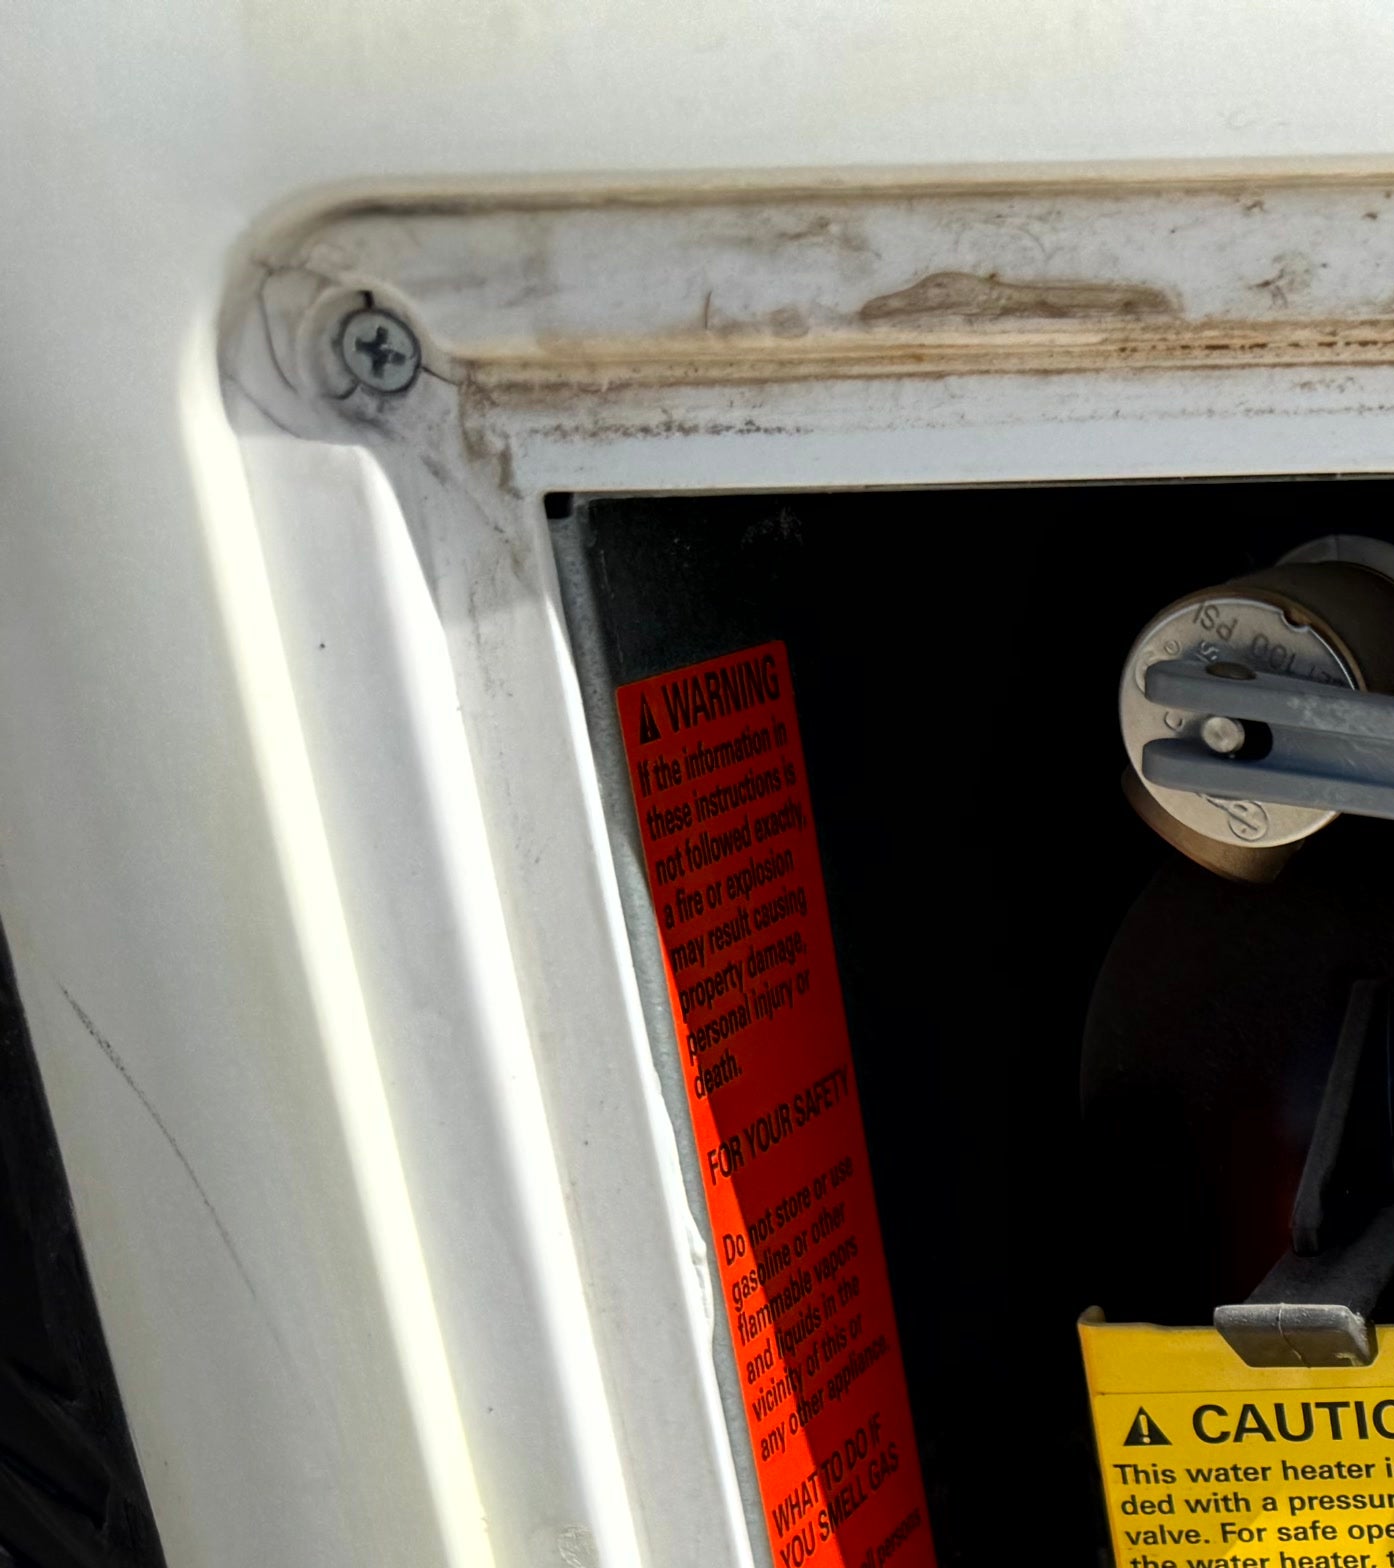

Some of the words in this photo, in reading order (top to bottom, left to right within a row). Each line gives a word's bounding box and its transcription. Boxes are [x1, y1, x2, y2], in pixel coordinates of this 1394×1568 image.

[1192, 605, 1237, 640] PSI
[661, 653, 781, 733] WARNING
[638, 762, 652, 797] If
[653, 755, 682, 791] the
[683, 727, 771, 780] information
[771, 715, 788, 747] in
[647, 803, 693, 841] these
[693, 767, 781, 822] instructions
[782, 756, 796, 784] is
[773, 1471, 819, 1537] WHAT
[822, 1451, 844, 1484] TO
[845, 1429, 868, 1469] DO
[870, 1414, 883, 1443] IF
[819, 1476, 868, 1542] SMELL
[870, 1444, 899, 1489] GAS
[1113, 1463, 1176, 1485] This
[1186, 1464, 1271, 1483] water
[1281, 1460, 1375, 1480] heater
[1121, 1494, 1174, 1515] ded
[1184, 1492, 1251, 1513] with
[1262, 1497, 1277, 1511] a
[1125, 1525, 1210, 1545] valve.
[1220, 1522, 1266, 1543] For
[1277, 1520, 1337, 1541] safe
